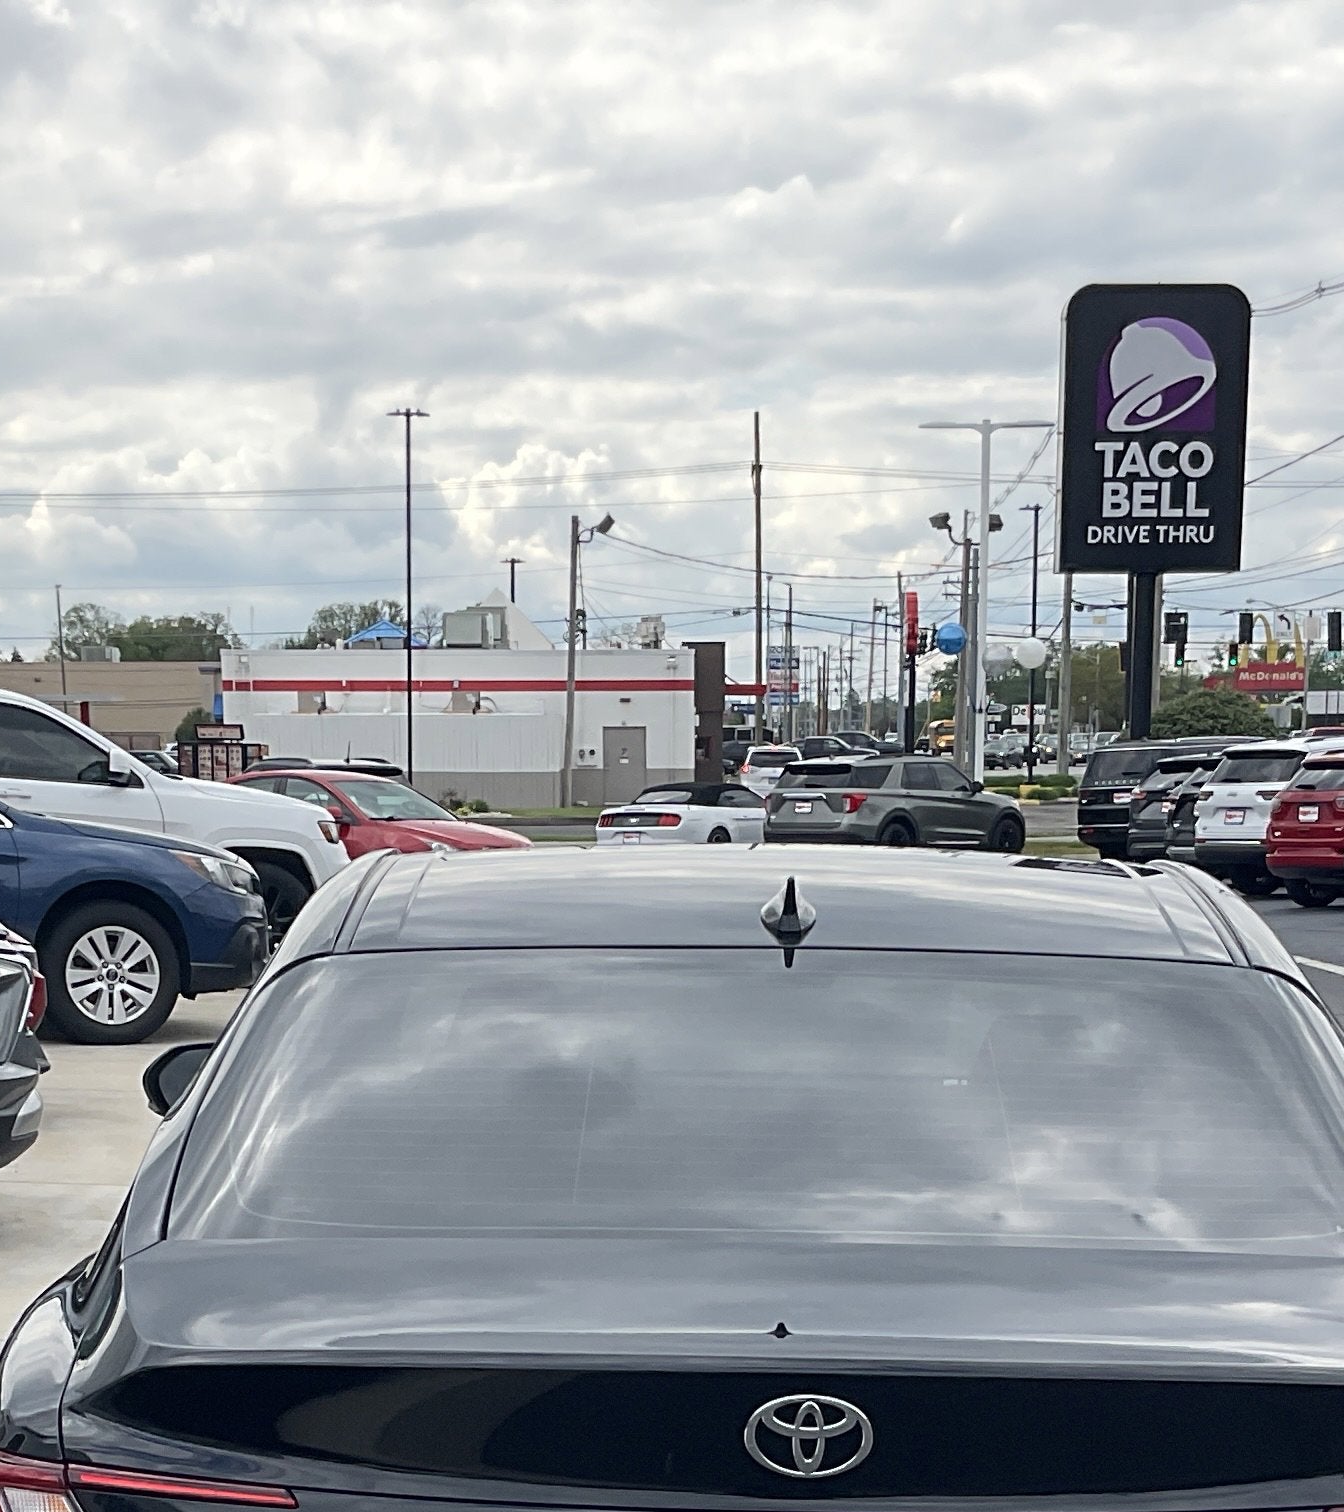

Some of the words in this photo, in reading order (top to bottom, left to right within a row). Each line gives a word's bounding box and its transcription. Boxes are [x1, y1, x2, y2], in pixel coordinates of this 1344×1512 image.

[1094, 441, 1214, 479] TACO
[1102, 481, 1210, 518] BELL
[1086, 525, 1150, 544] DRIVE
[1156, 525, 1215, 544] THRU
